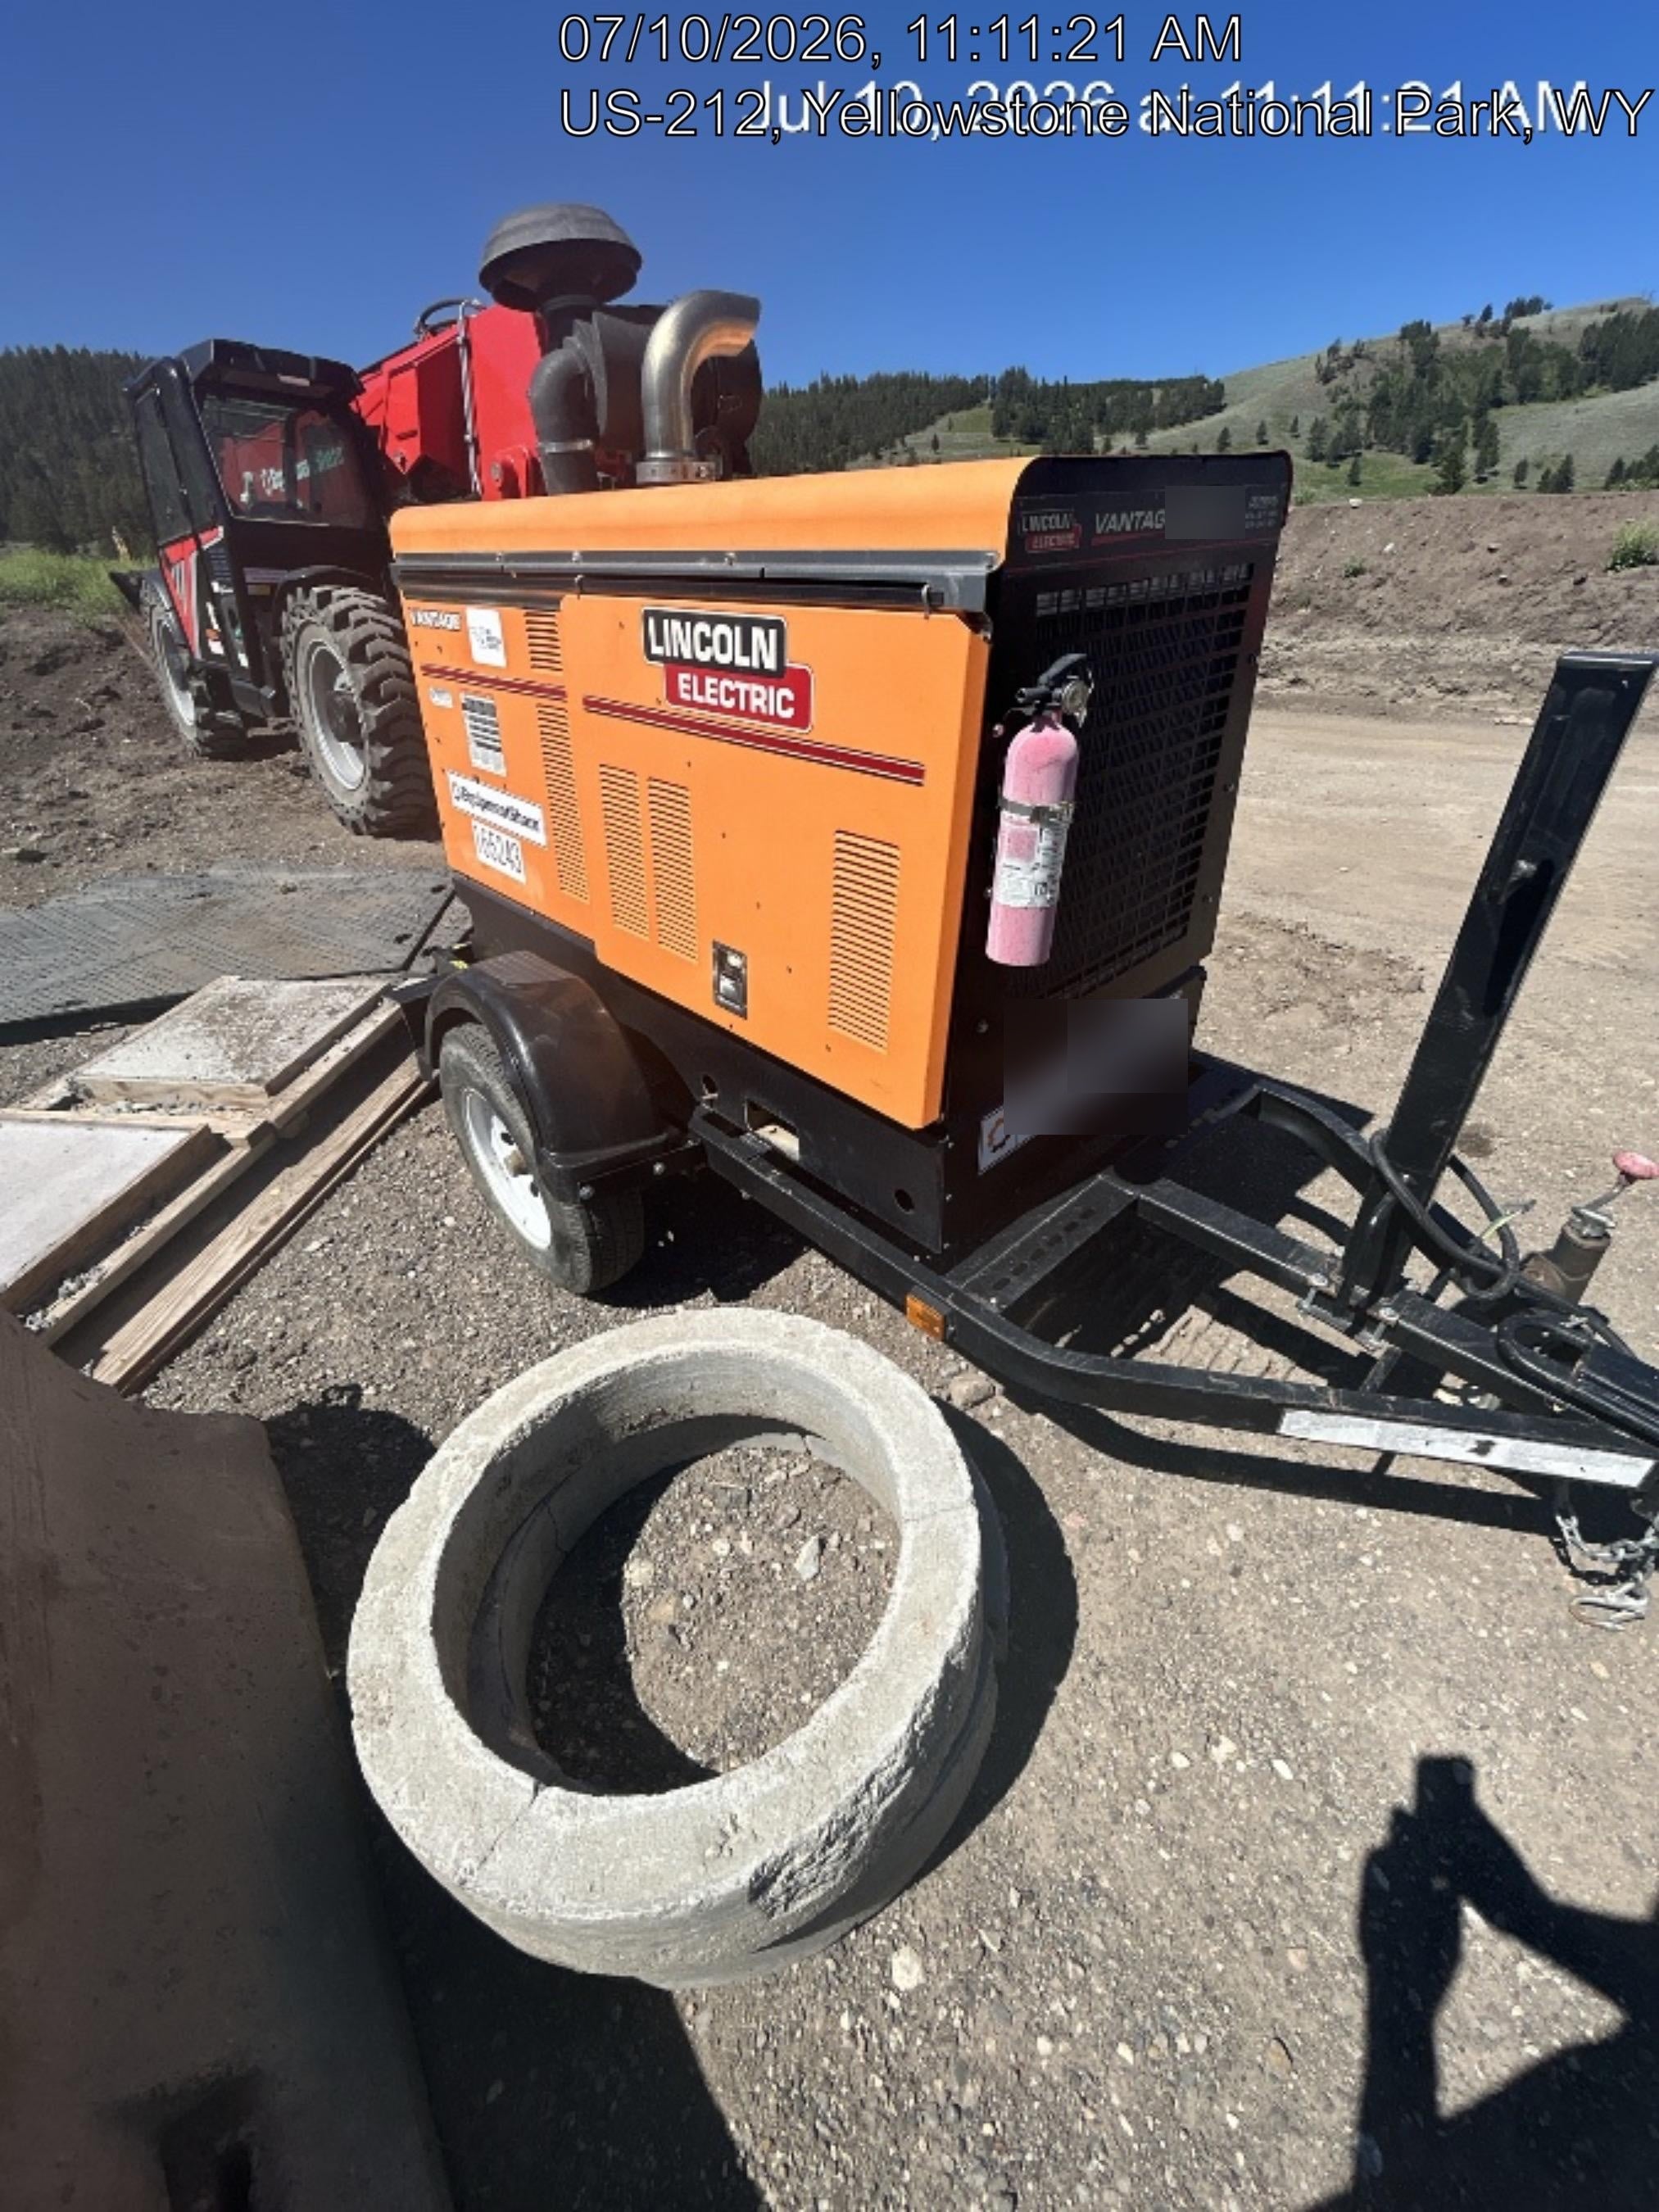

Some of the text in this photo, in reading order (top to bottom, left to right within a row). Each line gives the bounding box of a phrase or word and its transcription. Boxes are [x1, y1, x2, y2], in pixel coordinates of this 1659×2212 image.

[1095, 509, 1165, 533] VANTAG
[648, 616, 777, 671] LINCOLN
[678, 673, 795, 718] ELECTRIC
